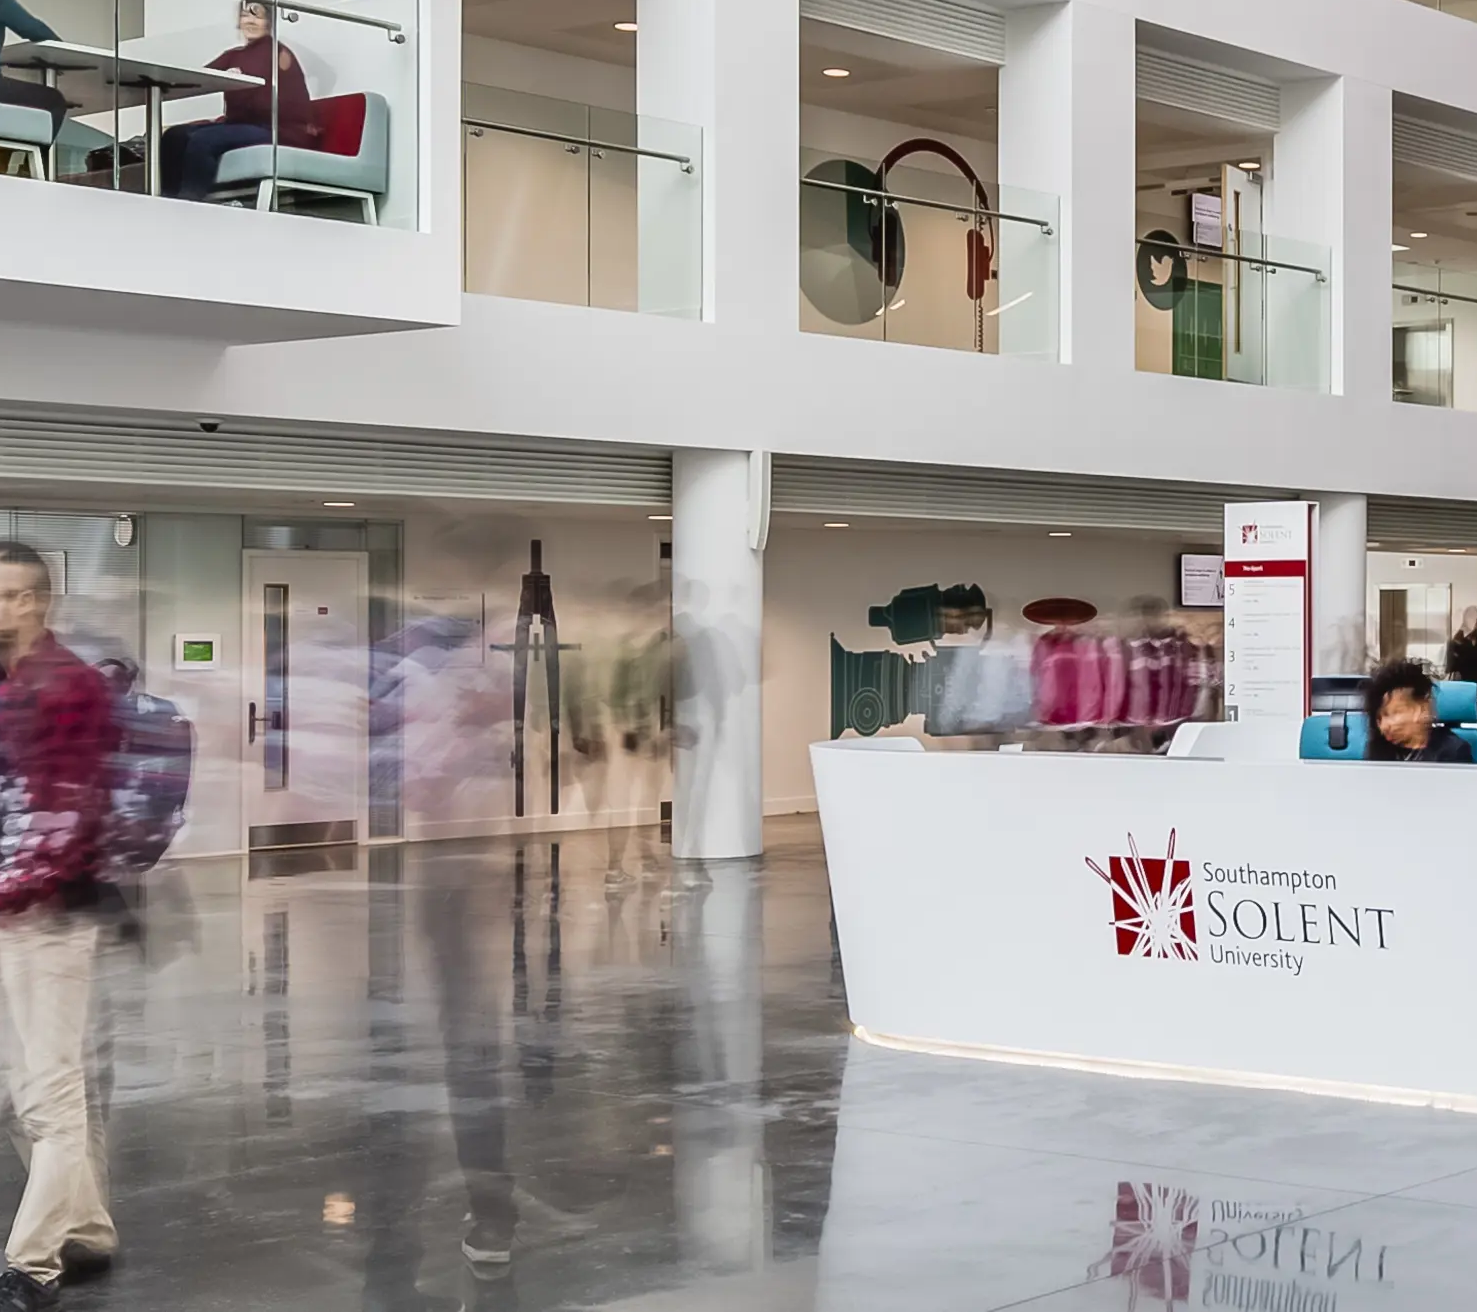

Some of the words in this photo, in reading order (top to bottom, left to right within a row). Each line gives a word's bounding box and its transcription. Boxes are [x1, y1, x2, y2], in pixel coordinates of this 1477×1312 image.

[1228, 583, 1235, 595] 5
[1228, 618, 1236, 629] 4
[1228, 651, 1236, 663] 3
[1228, 684, 1236, 696] 2
[1228, 710, 1236, 721] 1
[1202, 862, 1337, 894] Southampton
[1207, 890, 1395, 950] SOLENT
[1210, 943, 1304, 976] University
